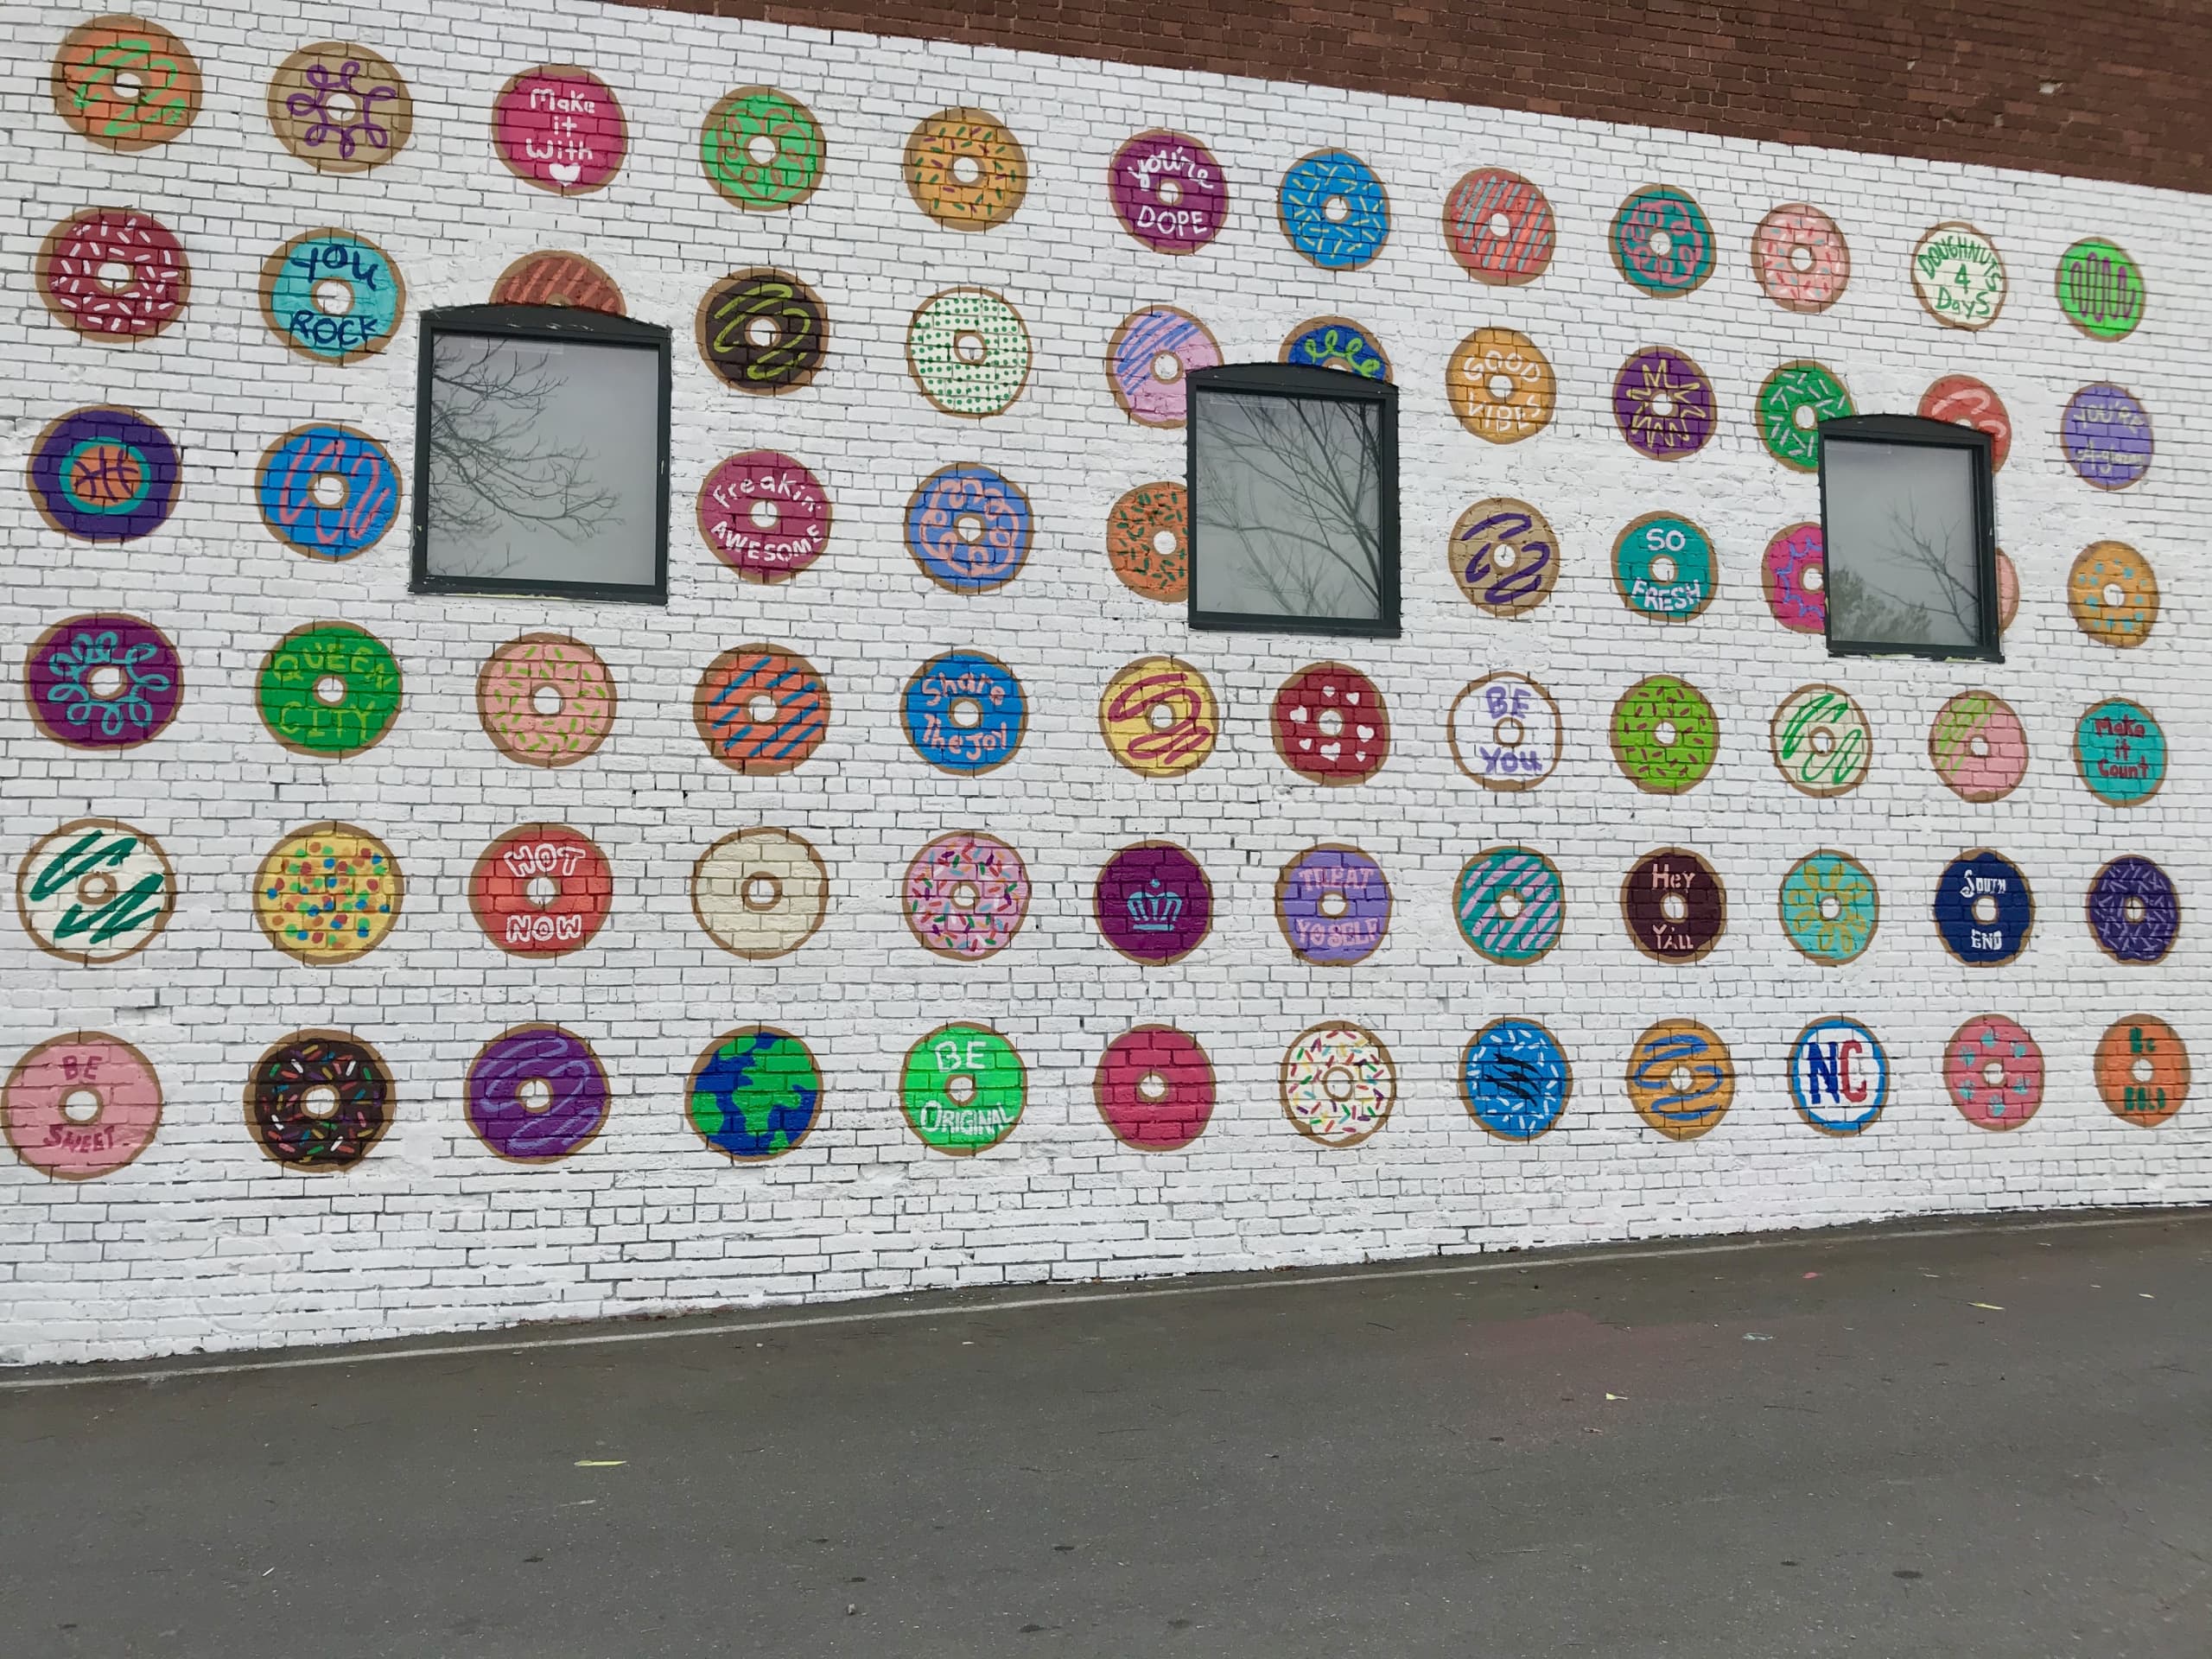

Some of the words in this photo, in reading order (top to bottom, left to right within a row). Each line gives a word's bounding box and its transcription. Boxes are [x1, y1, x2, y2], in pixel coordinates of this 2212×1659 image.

[530, 88, 595, 115] Make
[553, 116, 578, 137] it
[525, 138, 594, 162] With
[1137, 205, 1208, 238] DOPE
[1917, 235, 2002, 292] DOUGHNUTS
[1955, 263, 1972, 296] 4
[291, 309, 378, 346] ROCK
[1464, 349, 1541, 384] GOOD
[1469, 391, 1541, 432] VIBES
[711, 519, 824, 563] AWESOME
[1645, 528, 1686, 552] SO
[1631, 578, 1701, 612] FRESH
[273, 642, 394, 690] QUEEN
[922, 671, 1007, 707] Share
[1485, 685, 1532, 721] BE
[279, 701, 377, 742] CITY
[923, 713, 963, 754] The
[2116, 739, 2132, 761] it
[504, 842, 588, 878] HOT
[1299, 865, 1376, 891] TREAT
[505, 914, 583, 944] NOW
[1970, 927, 2003, 951] END
[62, 1055, 104, 1081] BE
[934, 1039, 988, 1073] BE
[1808, 1039, 1868, 1104] NC
[43, 1123, 116, 1154] SWEET
